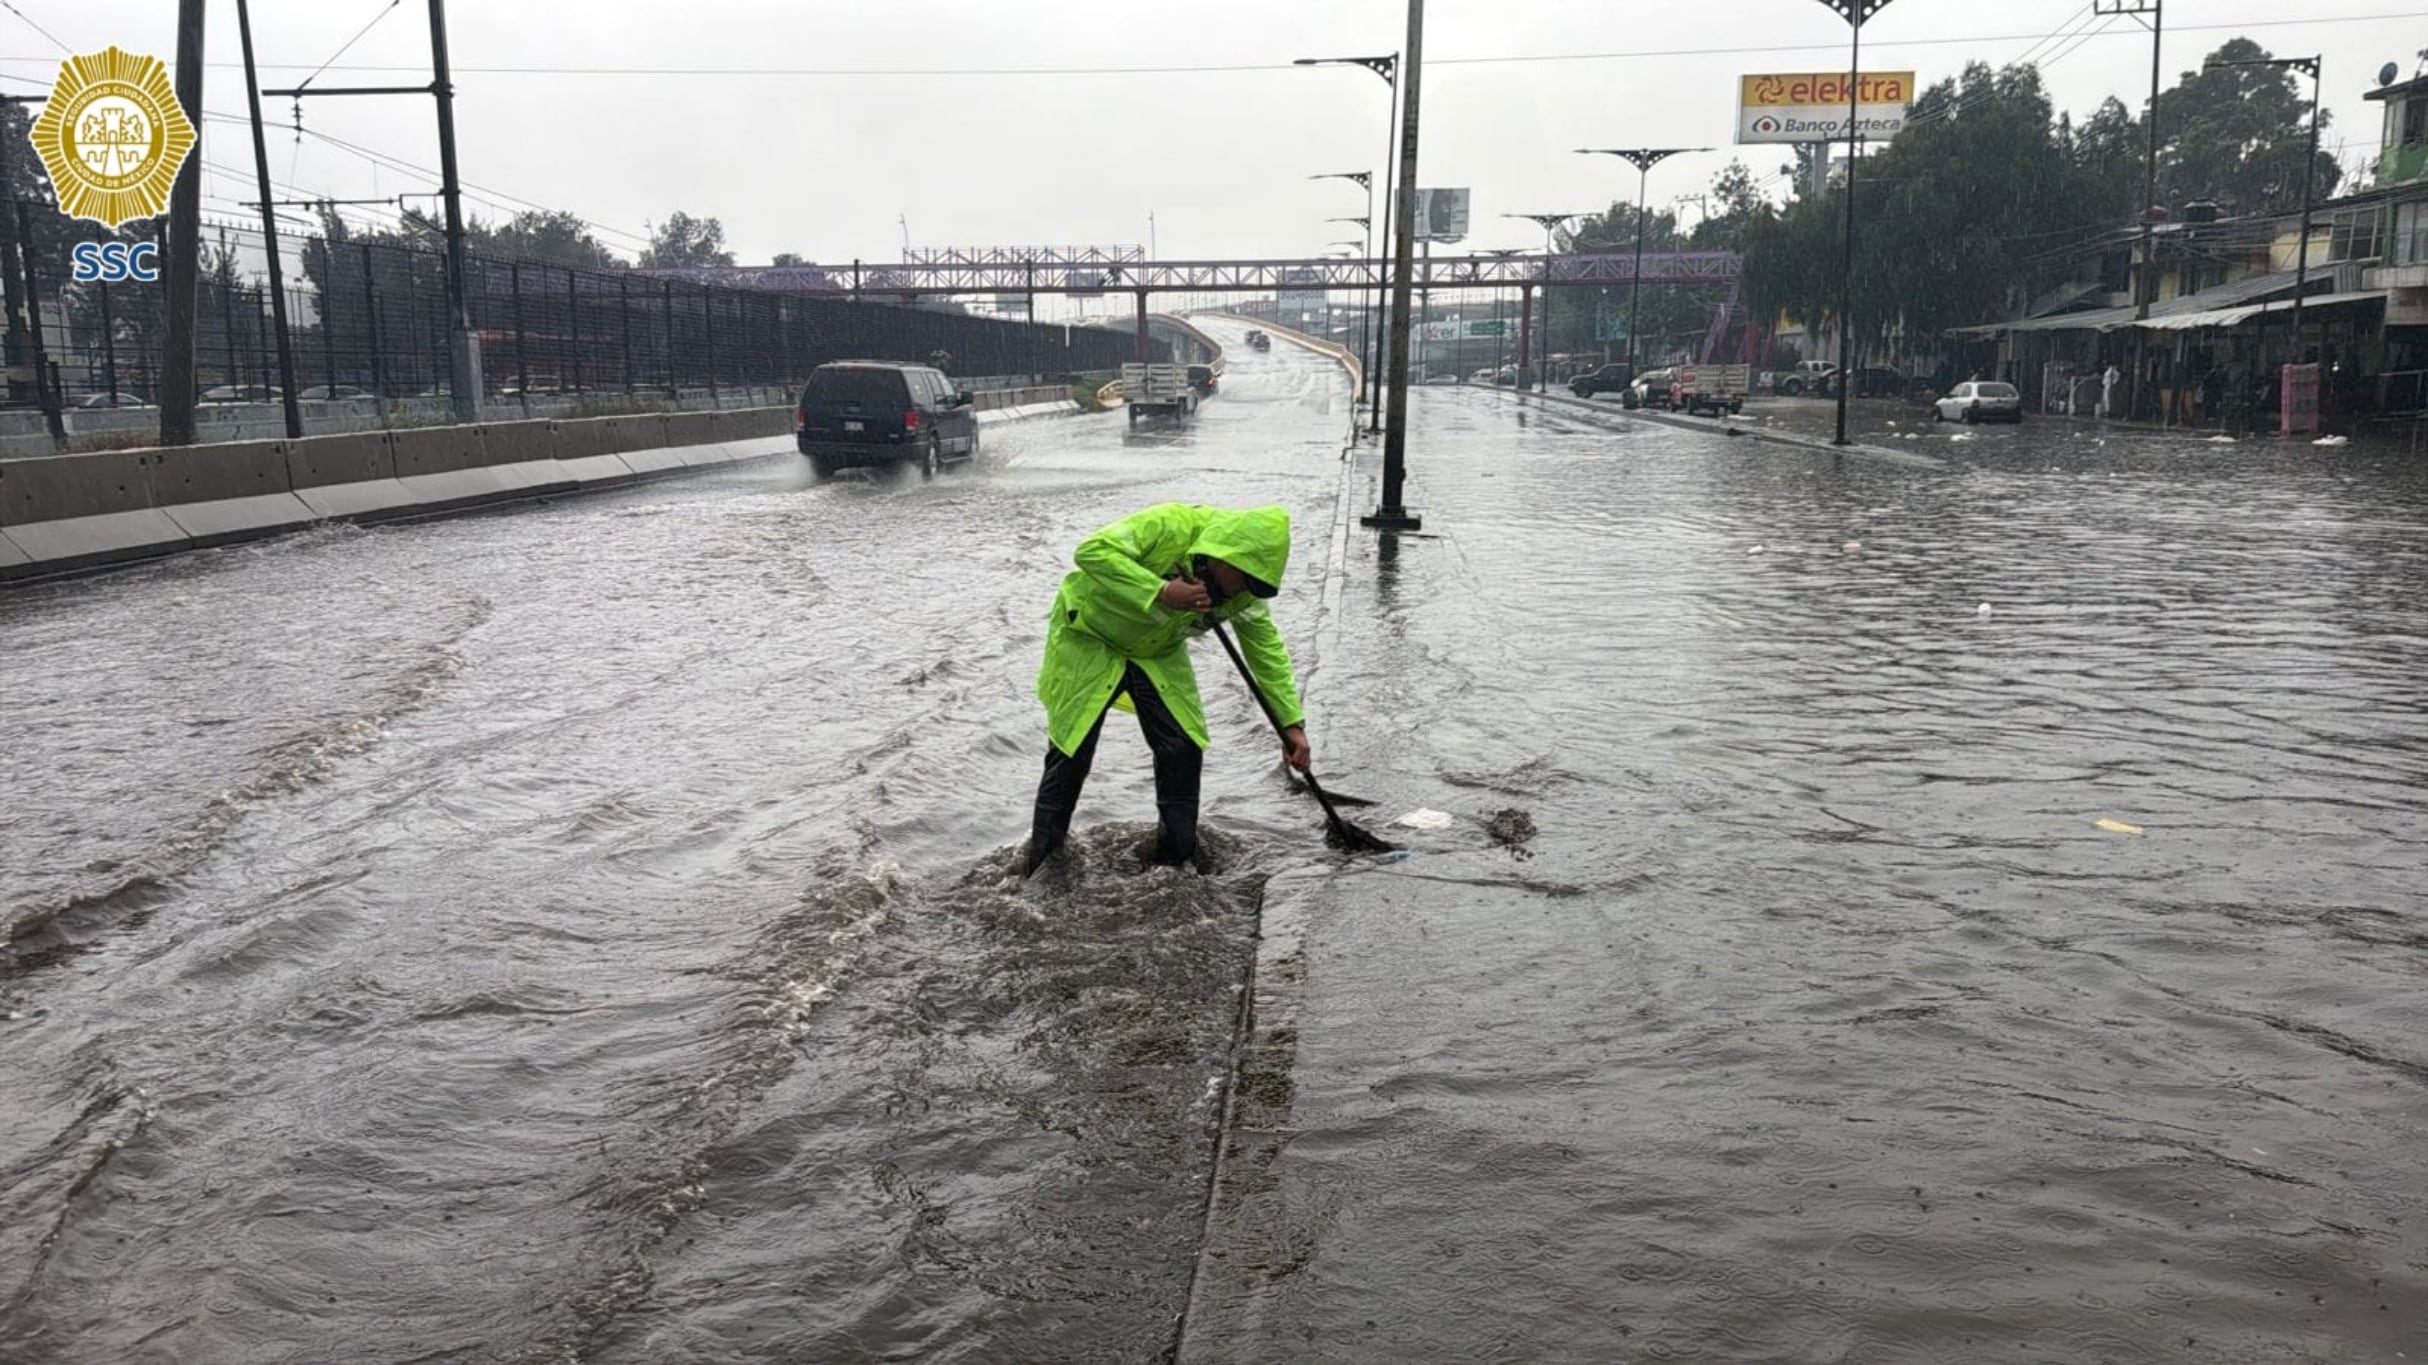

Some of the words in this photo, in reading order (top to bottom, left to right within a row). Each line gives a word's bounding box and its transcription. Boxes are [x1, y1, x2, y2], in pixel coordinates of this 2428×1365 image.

[1791, 75, 1901, 103] elektra
[1784, 118, 1837, 132] Banco
[1841, 117, 1901, 131] Azteca
